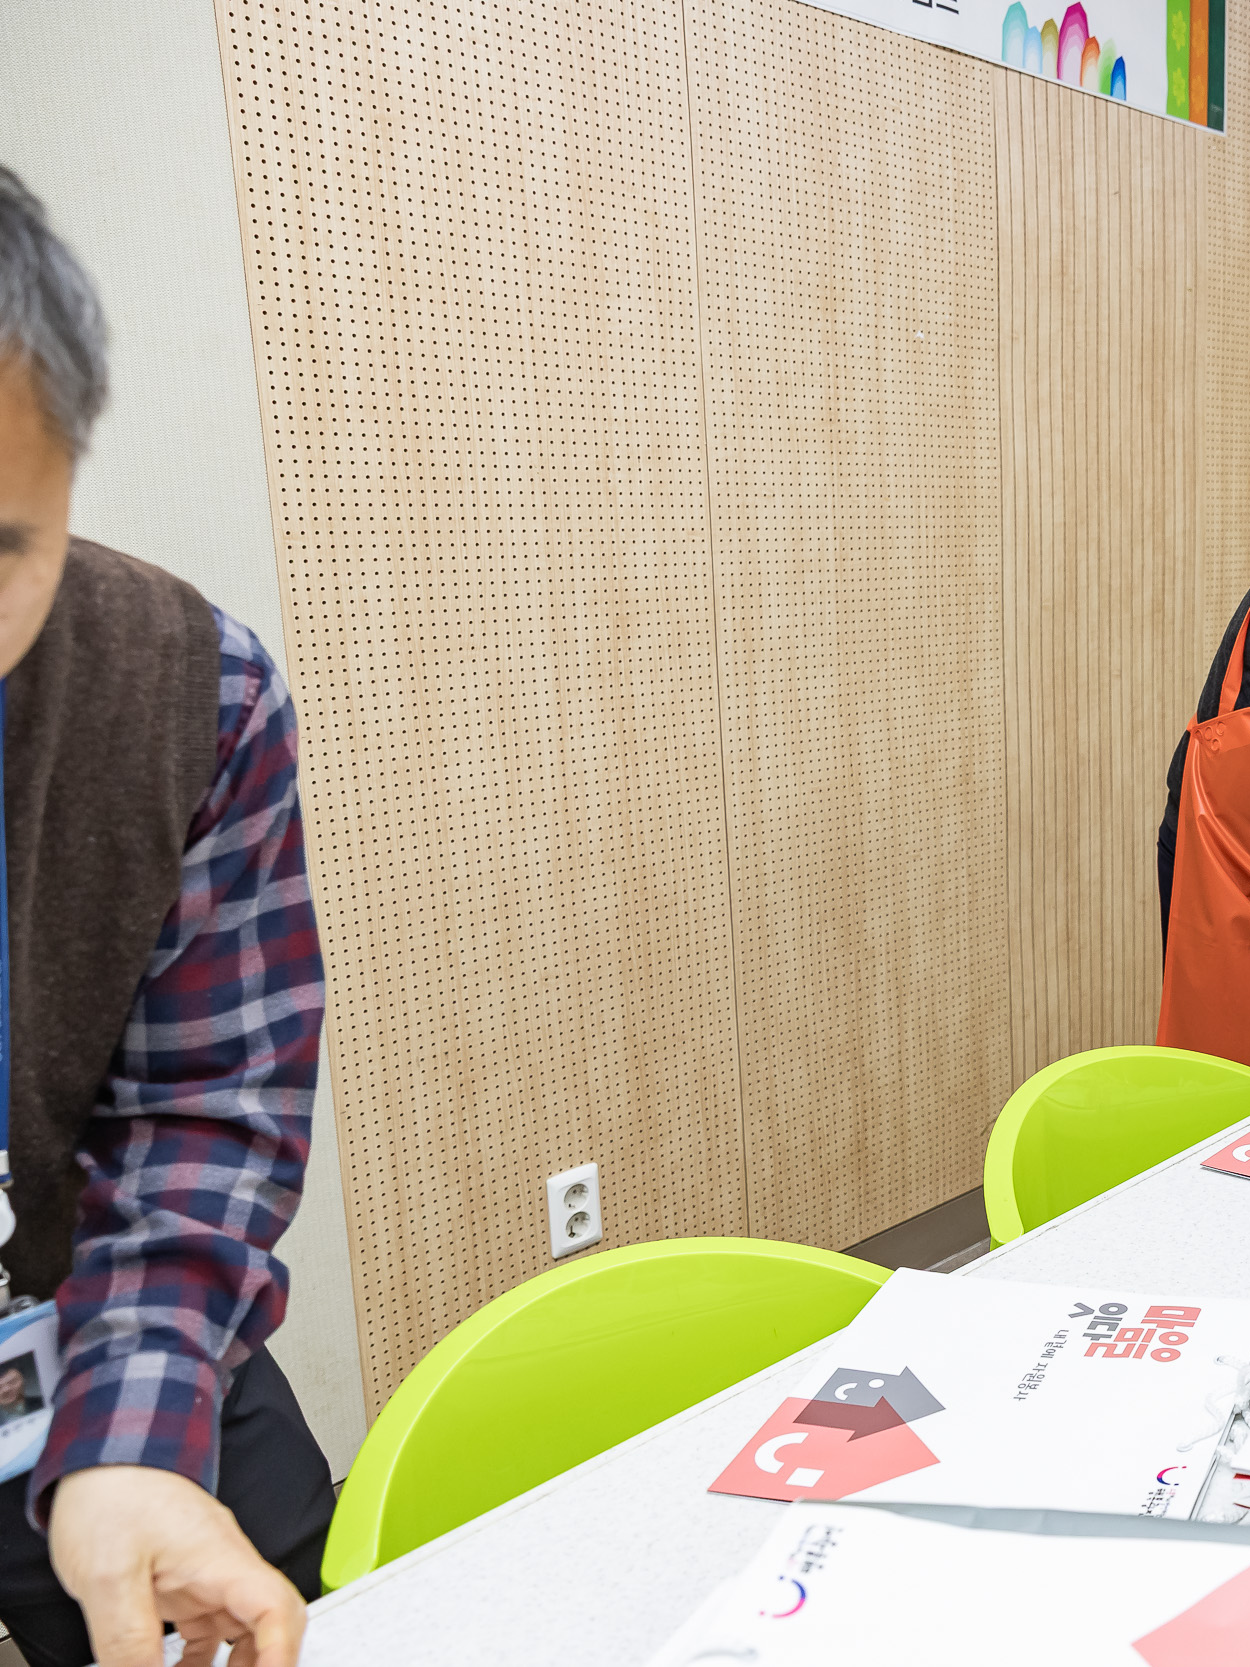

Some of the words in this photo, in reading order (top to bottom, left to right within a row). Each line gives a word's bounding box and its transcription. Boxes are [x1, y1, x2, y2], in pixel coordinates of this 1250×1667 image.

[1067, 1301, 1130, 1344] 잇다
[1083, 1304, 1202, 1364] 마음을
[1012, 1361, 1048, 1402] 자원봉사
